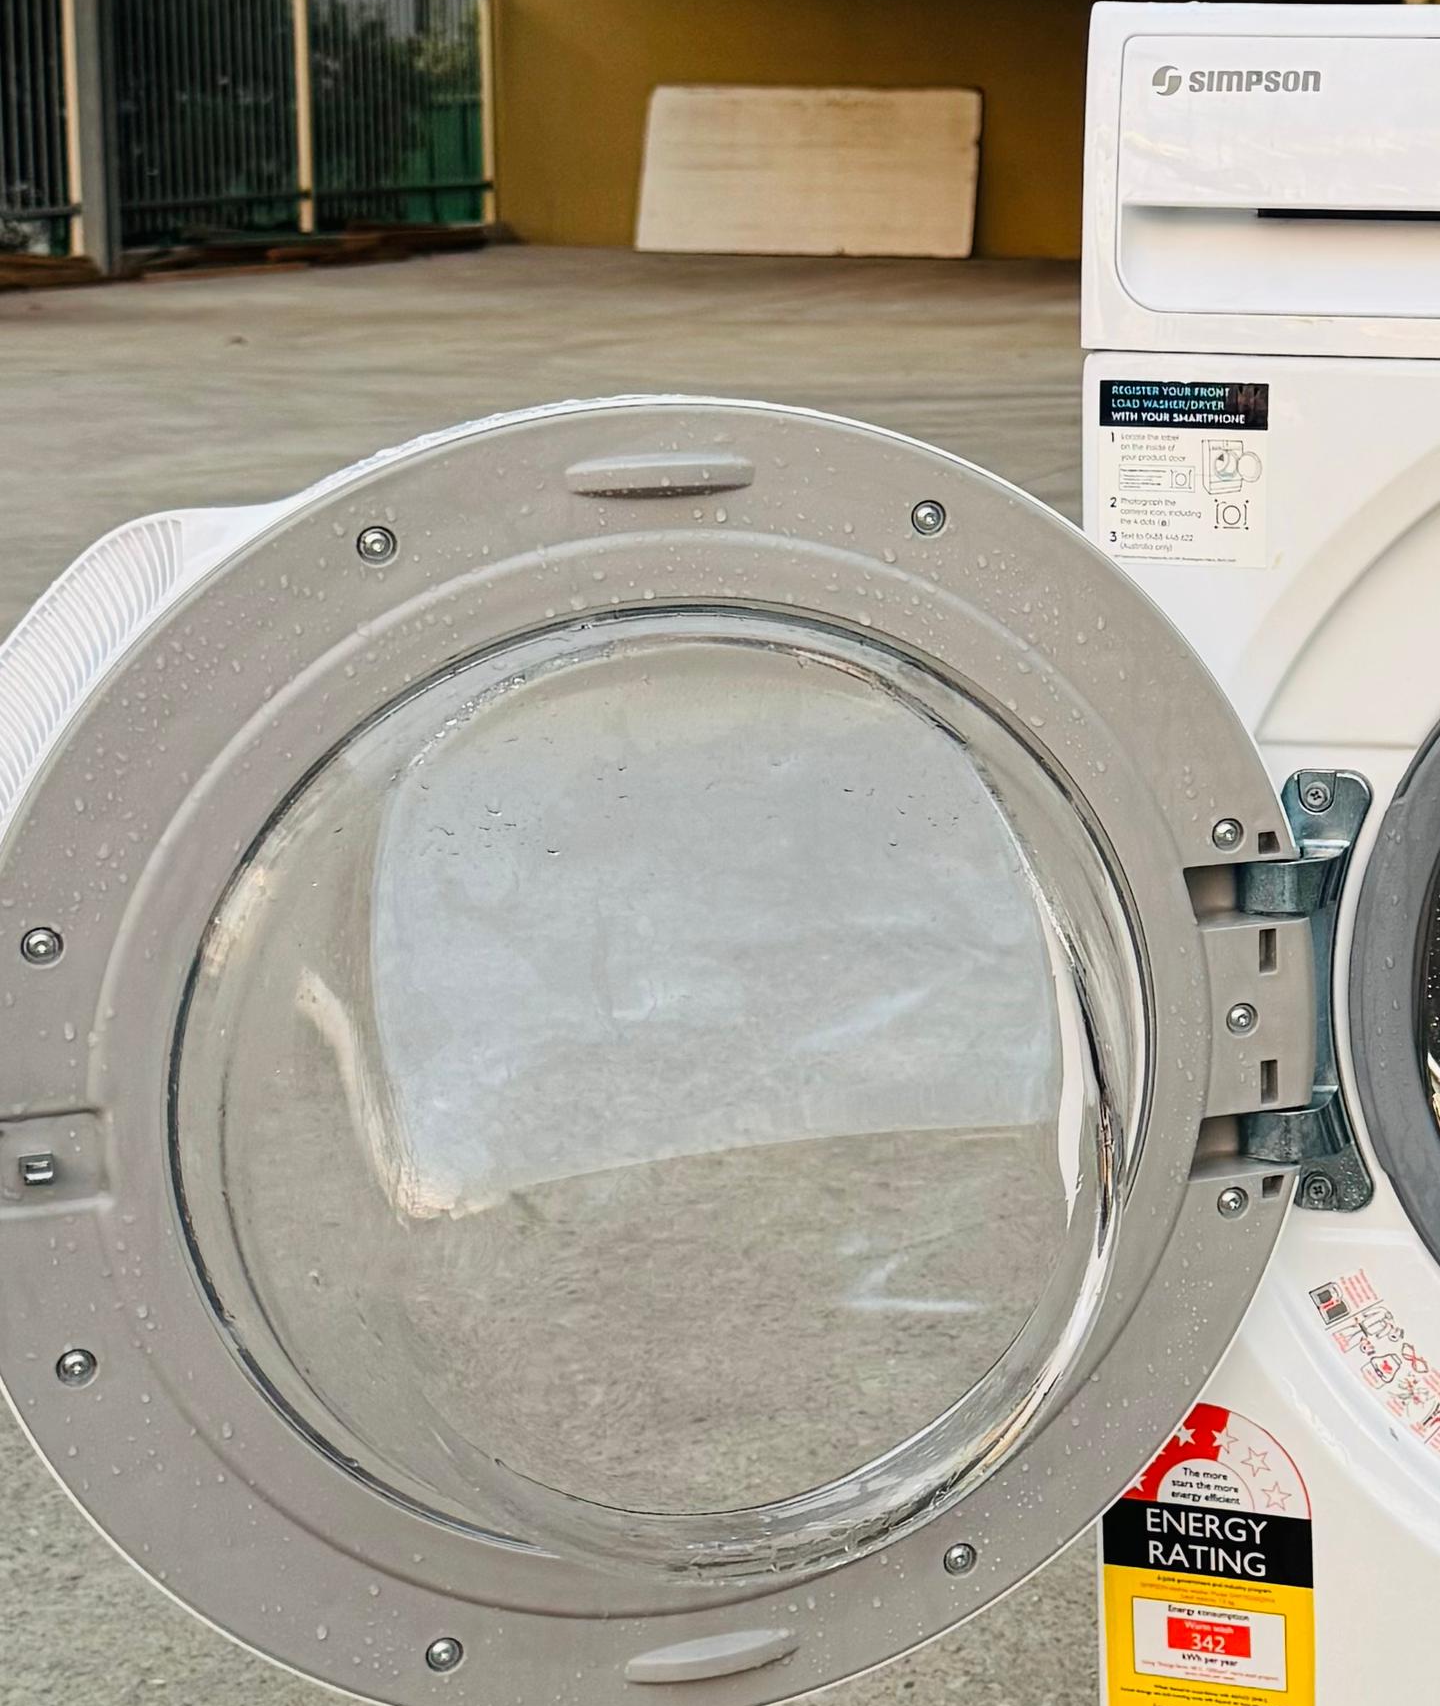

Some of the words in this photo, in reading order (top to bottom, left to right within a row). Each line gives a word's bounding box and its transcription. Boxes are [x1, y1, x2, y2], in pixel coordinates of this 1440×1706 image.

[1189, 71, 1321, 92] SIMPSON
[1112, 386, 1159, 395] REGISTER
[1162, 386, 1190, 396] YOUR
[1194, 387, 1230, 397] FRONT
[1112, 399, 1139, 408] LOAD
[1143, 400, 1224, 410] WASHER/DRYER
[1112, 411, 1137, 420] WITH
[1142, 412, 1169, 421] YOUR
[1173, 413, 1245, 424] SMARTPHONE
[1111, 432, 1114, 442] 1
[1110, 497, 1117, 507] 2
[1110, 532, 1117, 542] 3
[1182, 1467, 1199, 1477] The
[1203, 1471, 1228, 1481] more
[1172, 1480, 1193, 1488] stars
[1196, 1481, 1211, 1491] the
[1214, 1484, 1239, 1493] more
[1172, 1491, 1202, 1502] energy
[1204, 1494, 1240, 1505] efficient
[1146, 1508, 1267, 1544] ENERGY
[1148, 1540, 1266, 1577] RATING
[1168, 1604, 1194, 1616] Energy
[1197, 1610, 1249, 1621] consumption
[1192, 1634, 1226, 1653] 342
[1205, 1656, 1218, 1664] per
[1221, 1659, 1238, 1668] year
